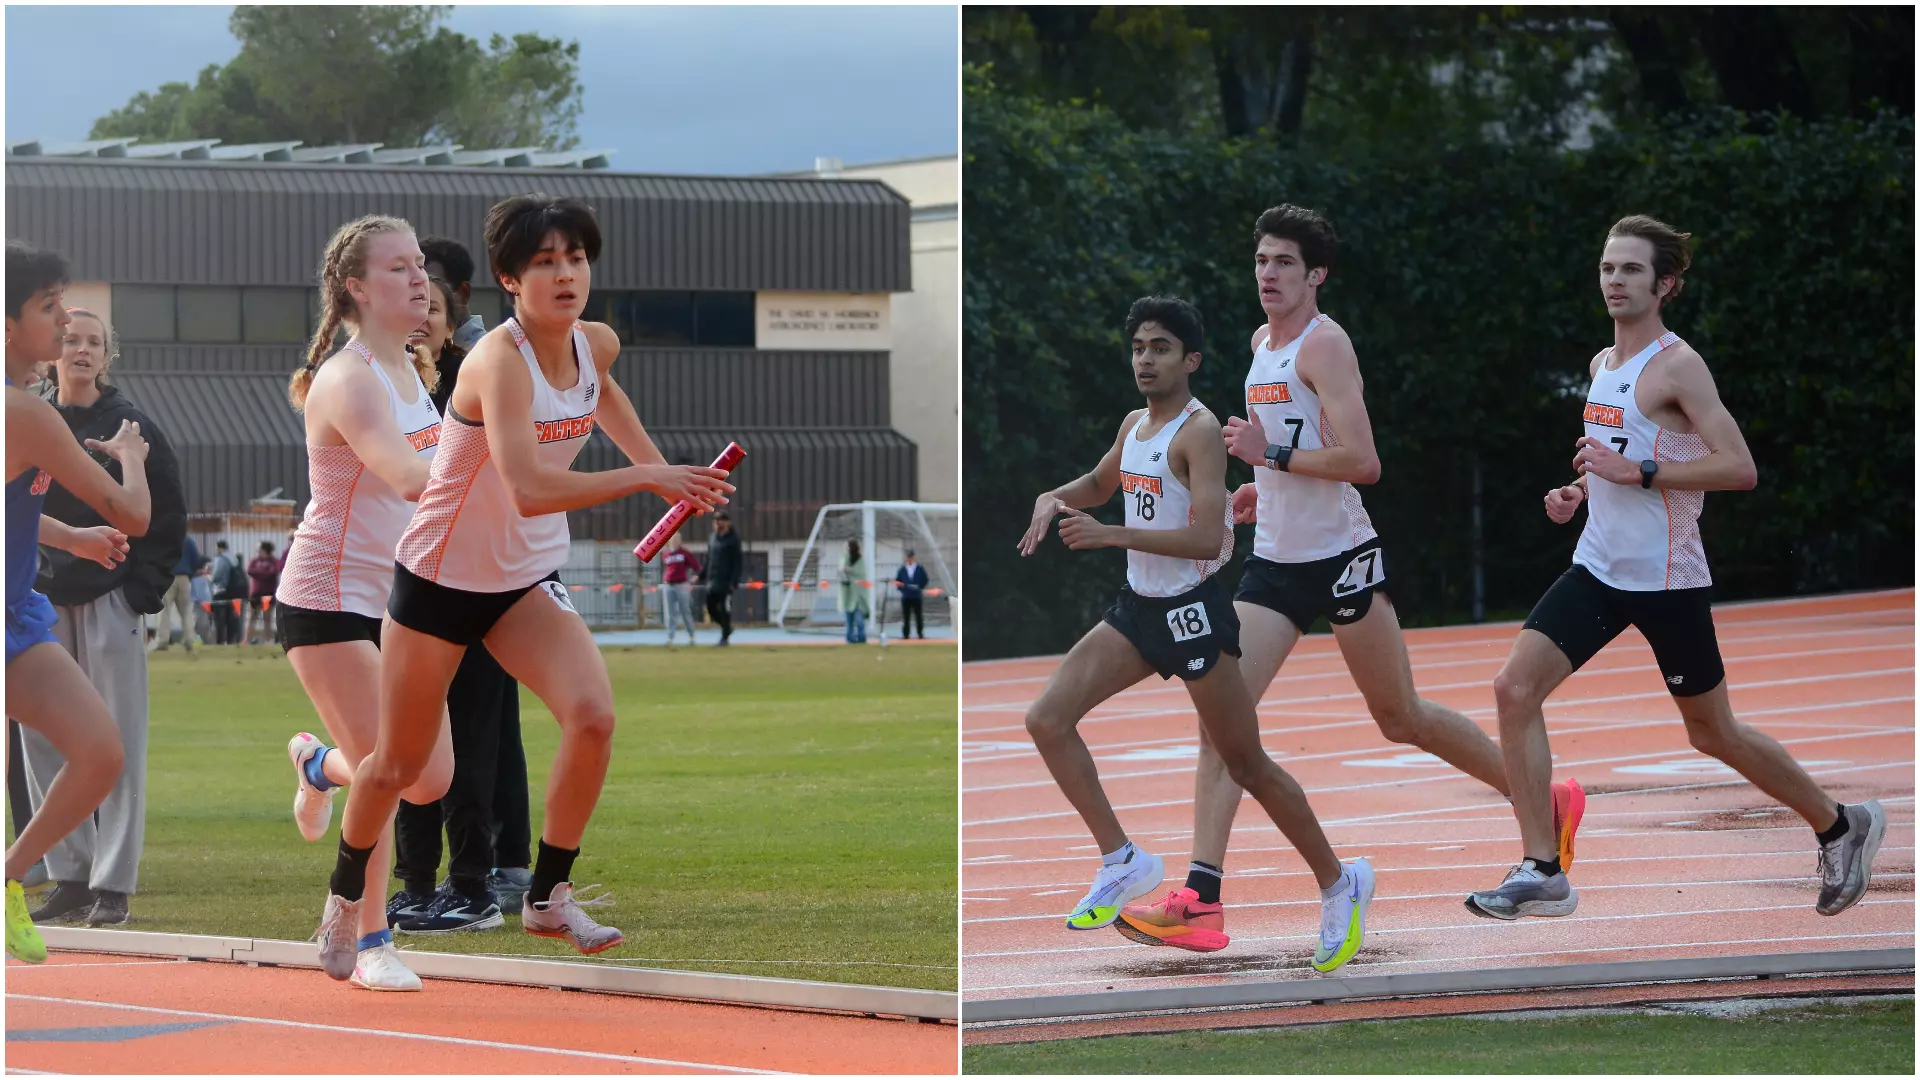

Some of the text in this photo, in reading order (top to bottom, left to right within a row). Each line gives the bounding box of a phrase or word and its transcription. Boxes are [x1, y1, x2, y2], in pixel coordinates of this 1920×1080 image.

[1247, 383, 1292, 404] CALTECH
[1135, 490, 1155, 521] 18
[1336, 550, 1377, 594] 27
[1170, 606, 1205, 637] 18
